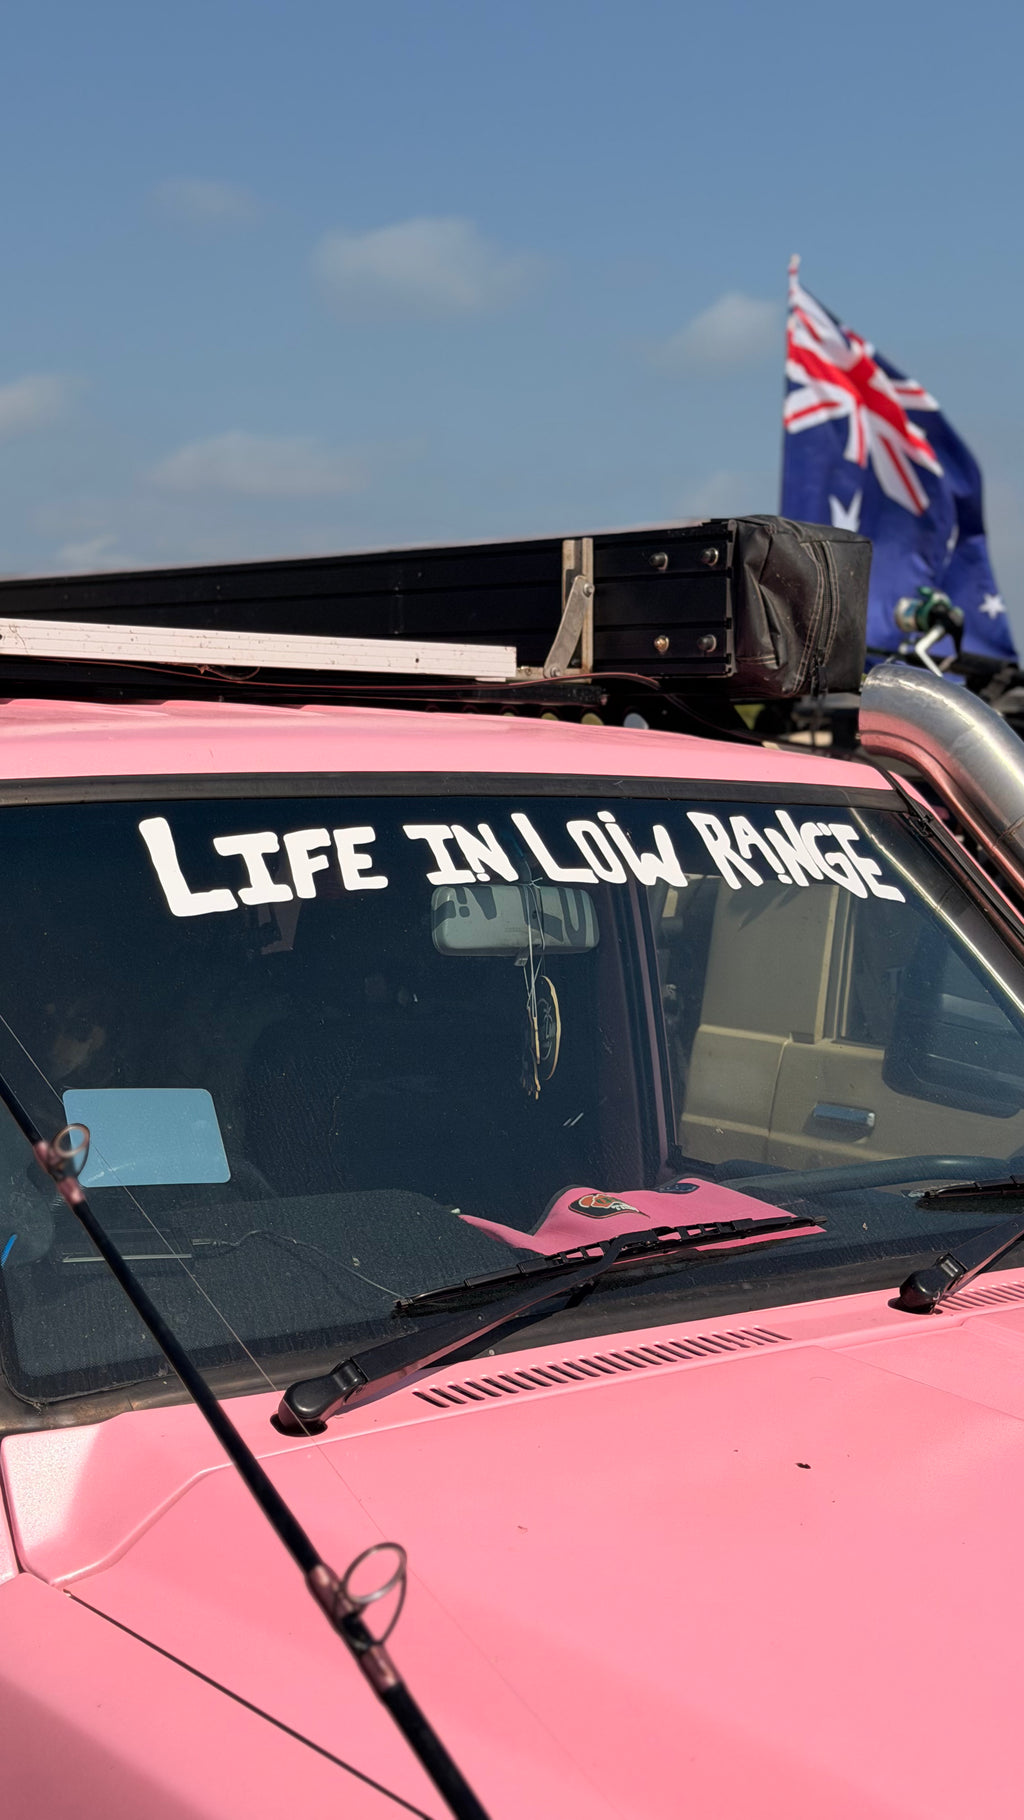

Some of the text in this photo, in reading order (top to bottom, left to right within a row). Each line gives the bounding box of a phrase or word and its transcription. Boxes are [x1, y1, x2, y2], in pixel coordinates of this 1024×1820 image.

[138, 810, 906, 917] LIFE IN LOW RANGE
